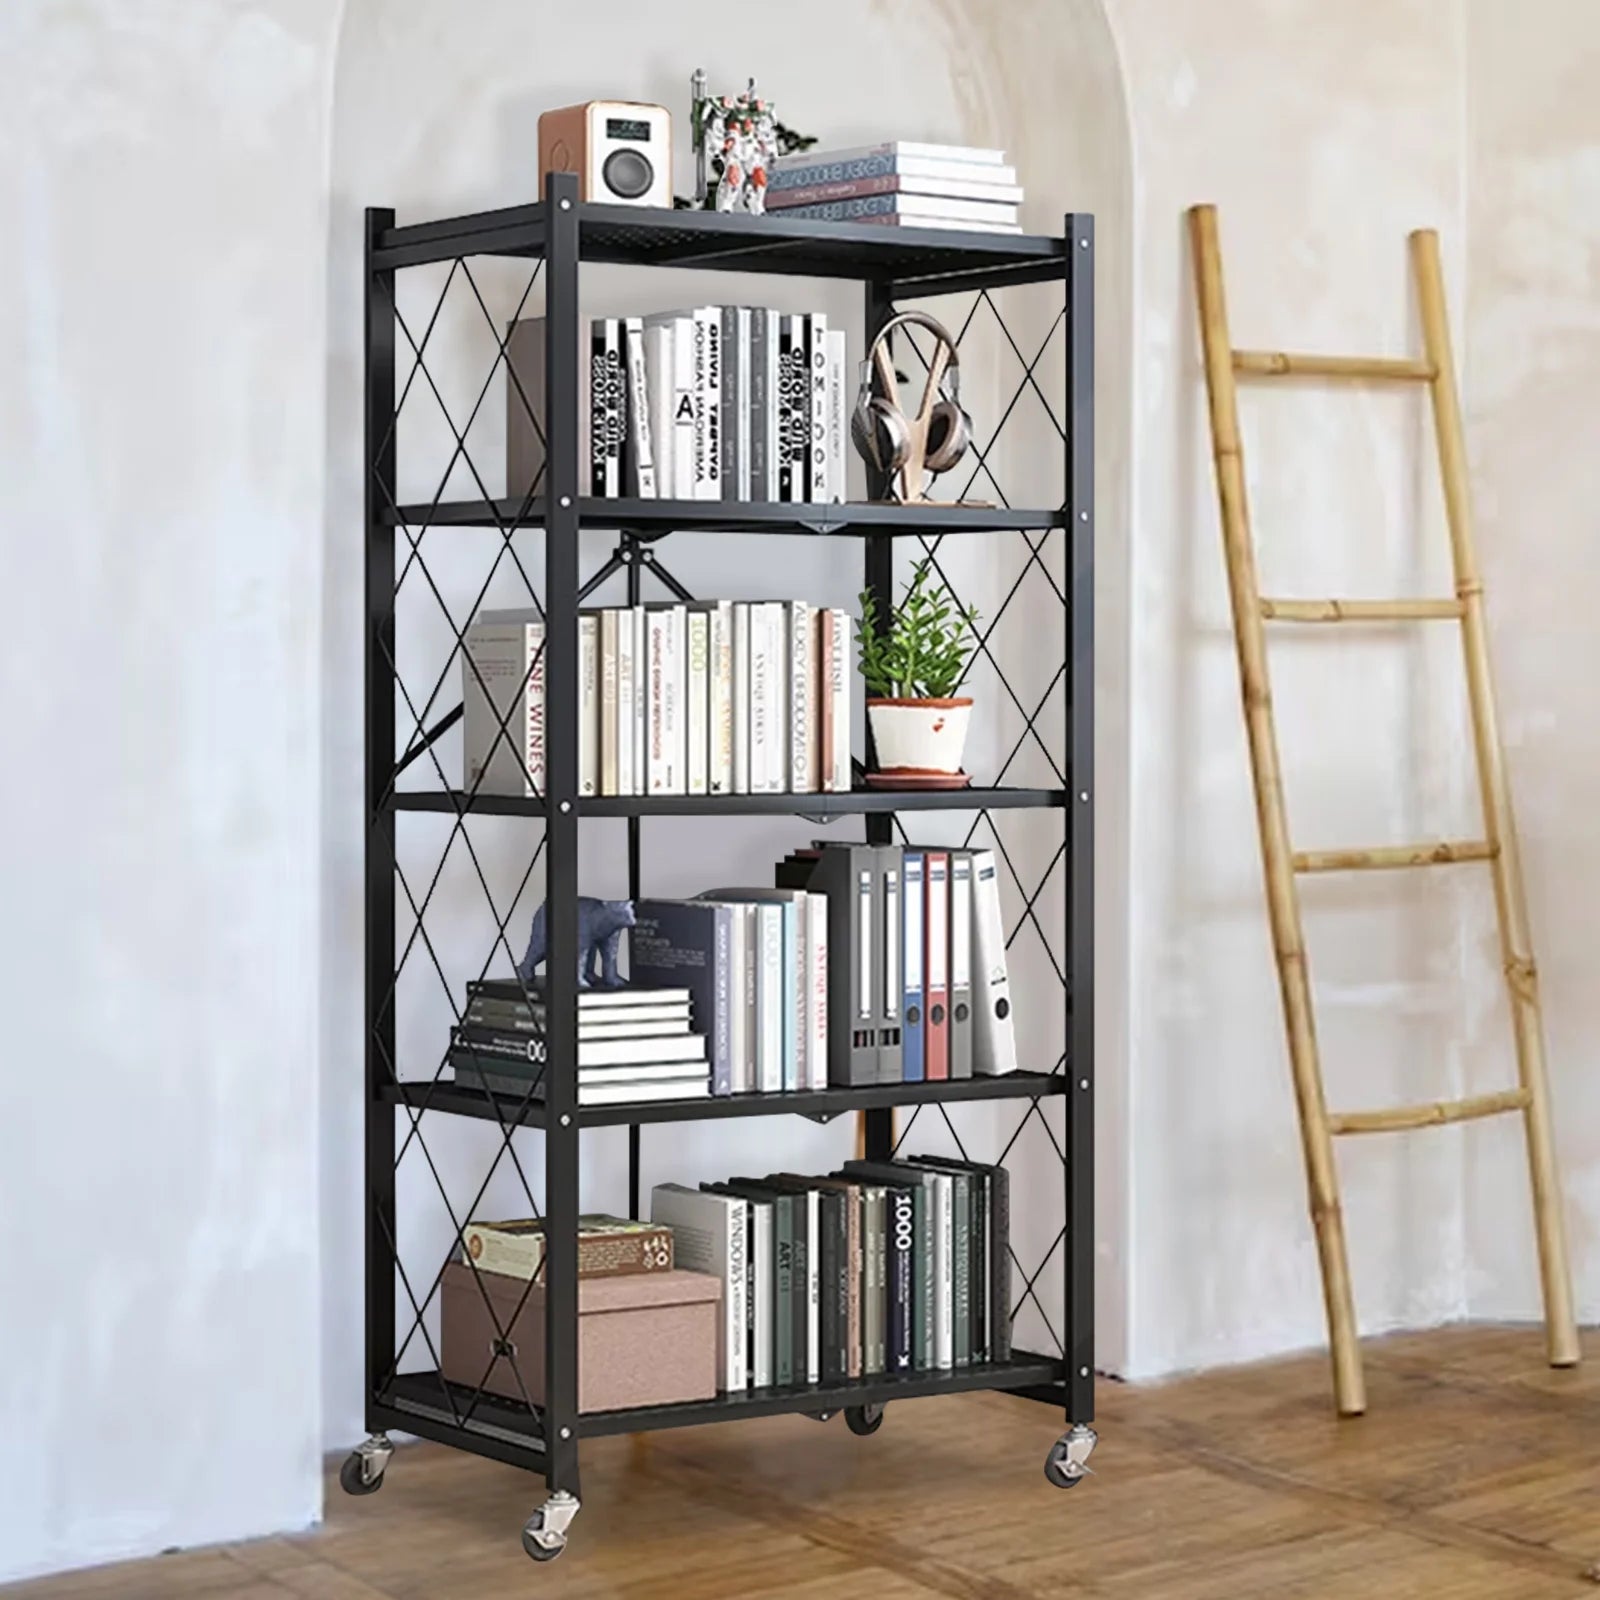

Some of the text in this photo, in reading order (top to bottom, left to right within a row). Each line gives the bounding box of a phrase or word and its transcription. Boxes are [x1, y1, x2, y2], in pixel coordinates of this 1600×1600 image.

[692, 618, 705, 672] 1000
[530, 704, 544, 774] WINES
[730, 1206, 744, 1286] WINDOWS
[896, 1196, 912, 1250] 1000
[780, 1242, 790, 1271] ART
